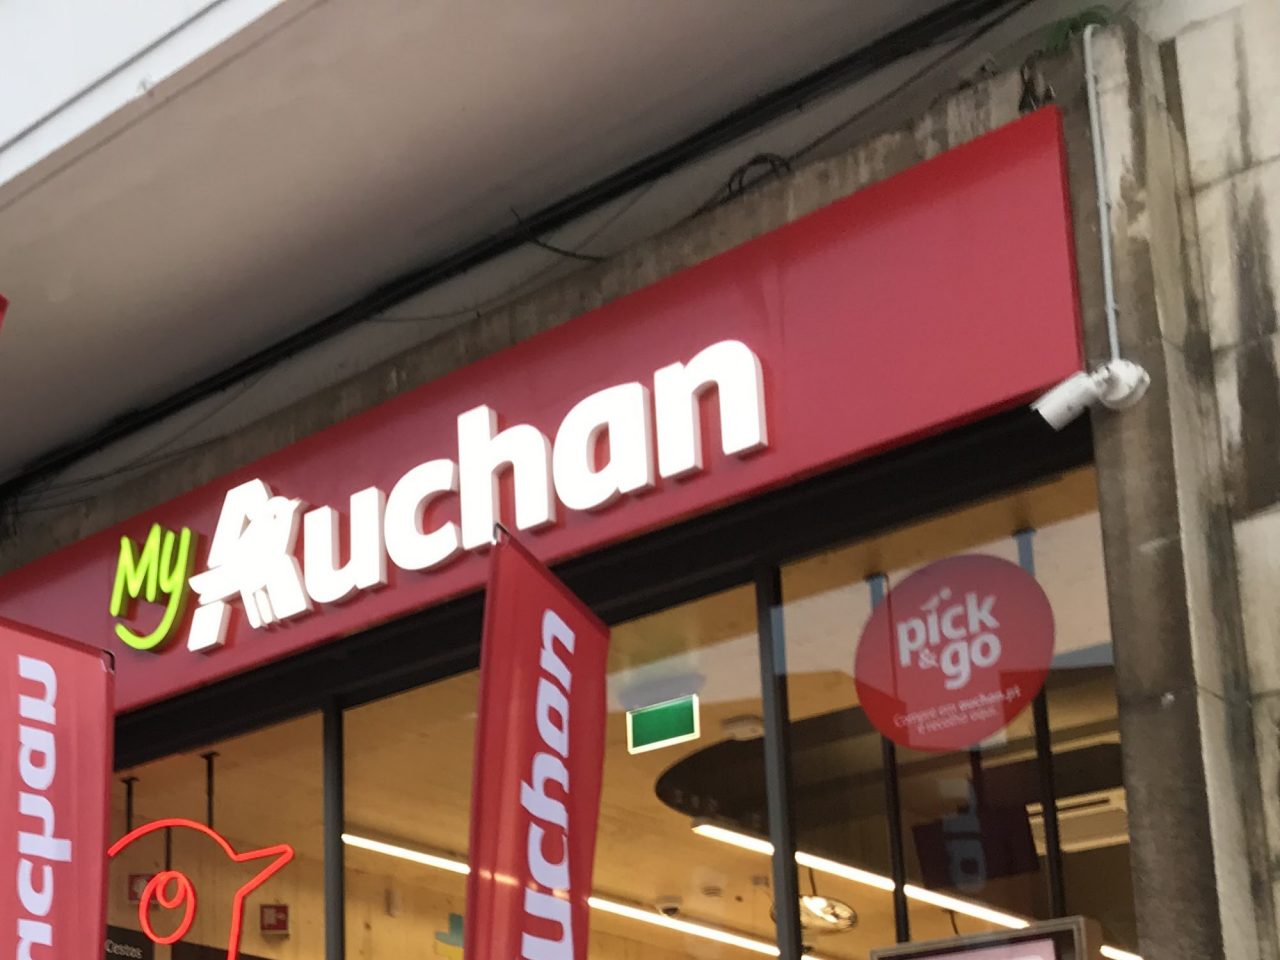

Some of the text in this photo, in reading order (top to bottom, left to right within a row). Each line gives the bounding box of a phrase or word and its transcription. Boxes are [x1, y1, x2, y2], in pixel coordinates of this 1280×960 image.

[109, 339, 768, 653] My Auchan
[896, 586, 1000, 667] pick
[940, 632, 1002, 690] go
